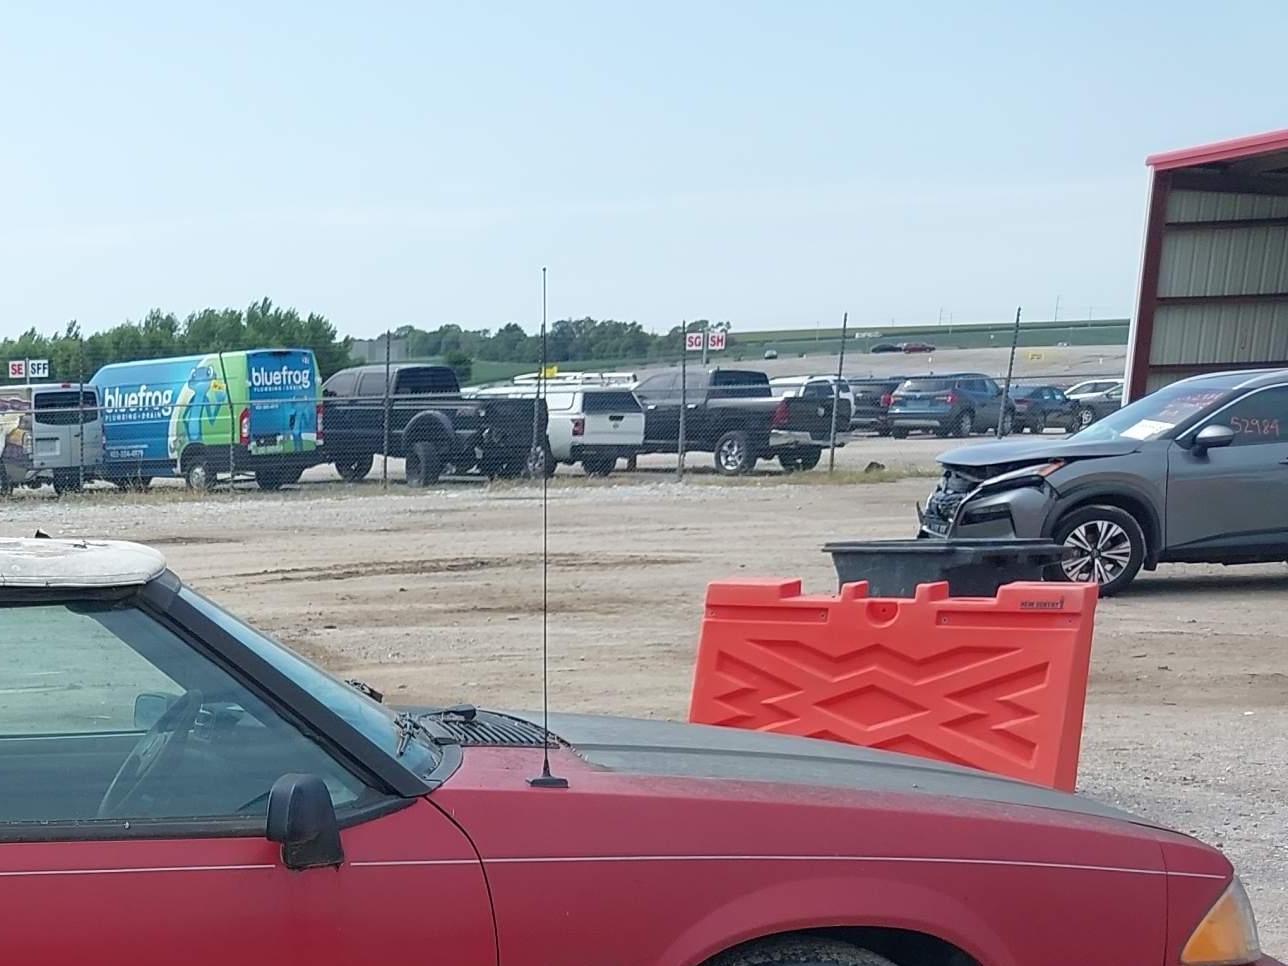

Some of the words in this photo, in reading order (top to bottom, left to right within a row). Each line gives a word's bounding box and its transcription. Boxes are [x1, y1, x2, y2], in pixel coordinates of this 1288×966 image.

[687, 335, 702, 348] SG
[710, 335, 724, 348] SH
[11, 363, 24, 375] SE
[31, 362, 48, 375] SFF
[252, 365, 311, 389] bluefrog
[105, 384, 173, 417] bluefrog
